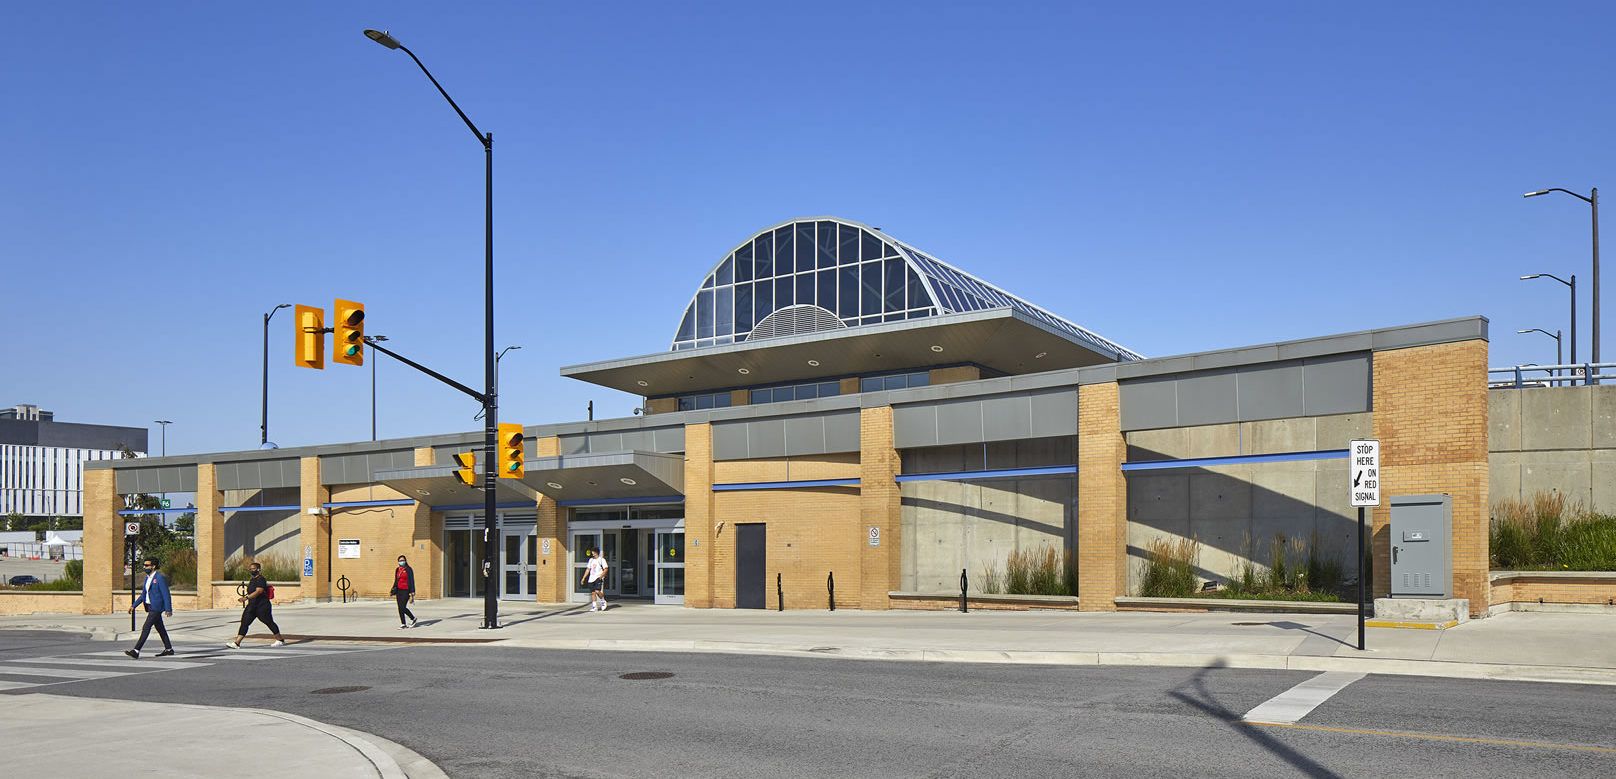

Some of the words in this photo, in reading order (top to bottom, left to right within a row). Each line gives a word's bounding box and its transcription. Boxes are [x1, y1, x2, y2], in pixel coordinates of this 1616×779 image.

[1356, 445, 1374, 454] STOP
[1356, 457, 1374, 466] HERE
[1367, 469, 1377, 477] ON
[1364, 480, 1377, 489] RED
[1355, 492, 1376, 501] SIGNAL
